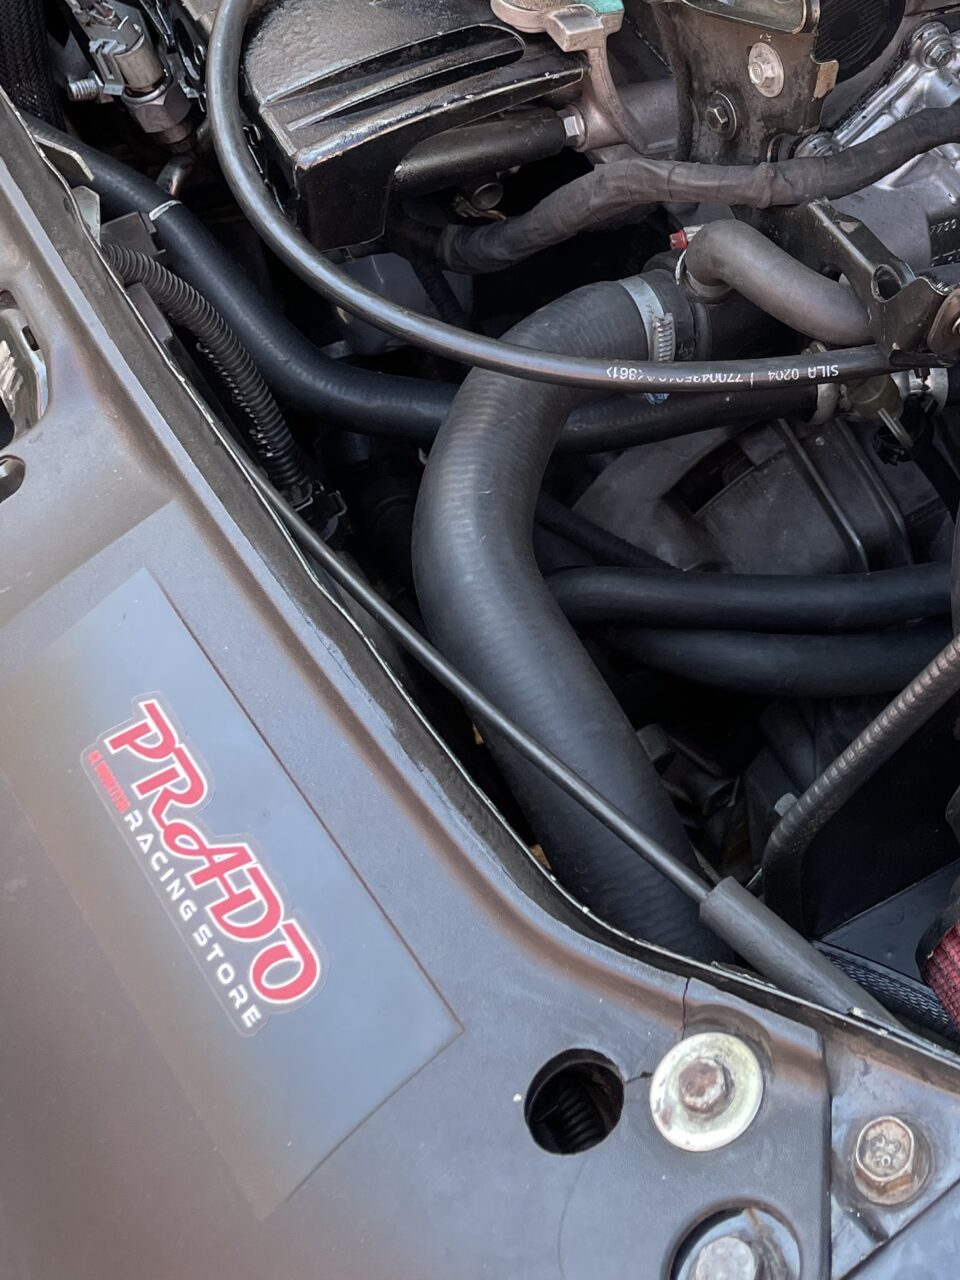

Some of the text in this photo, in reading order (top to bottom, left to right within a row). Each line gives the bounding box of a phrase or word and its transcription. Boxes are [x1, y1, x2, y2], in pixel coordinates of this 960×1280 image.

[768, 368, 800, 382] 0204
[807, 364, 839, 379] SILA
[103, 698, 321, 1004] PRADO
[124, 809, 262, 1027] RACING STORE
